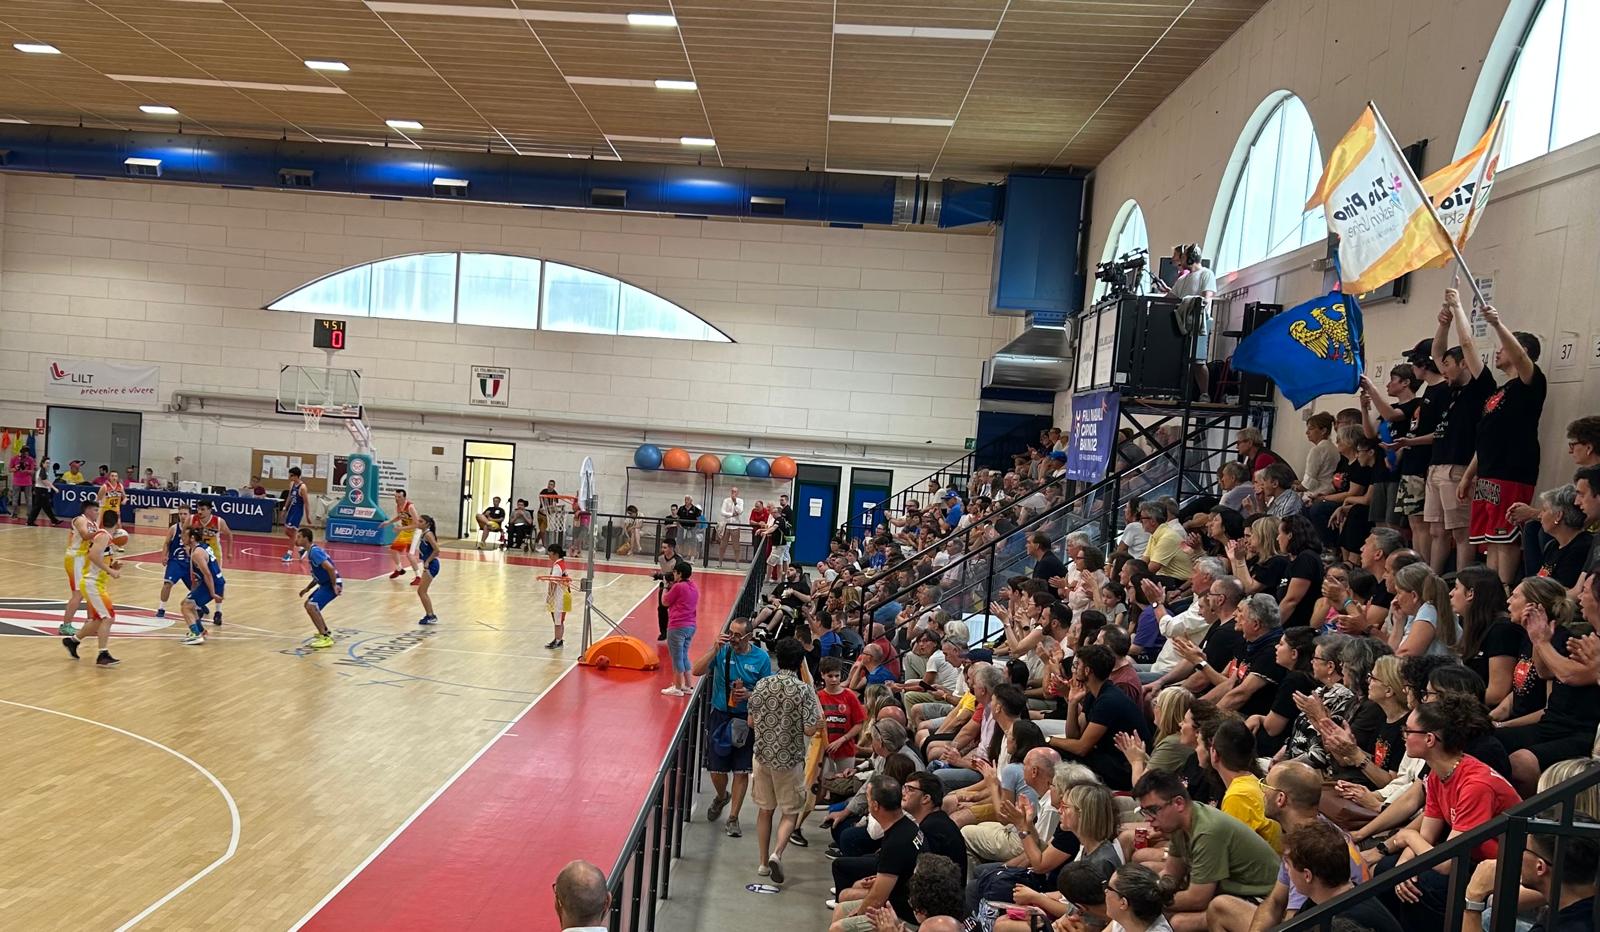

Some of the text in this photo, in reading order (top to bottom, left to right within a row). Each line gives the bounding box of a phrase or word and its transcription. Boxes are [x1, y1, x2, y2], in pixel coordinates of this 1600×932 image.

[332, 331, 343, 348] 0
[1561, 343, 1573, 360] 37
[71, 373, 94, 384] LILT
[80, 387, 119, 395] prevenire
[128, 386, 154, 394] vivere
[62, 490, 77, 501] IO
[126, 494, 160, 507] FRIULI
[163, 497, 218, 512] VENEA
[220, 501, 264, 516] GIULIA
[334, 527, 353, 535] MEDI
